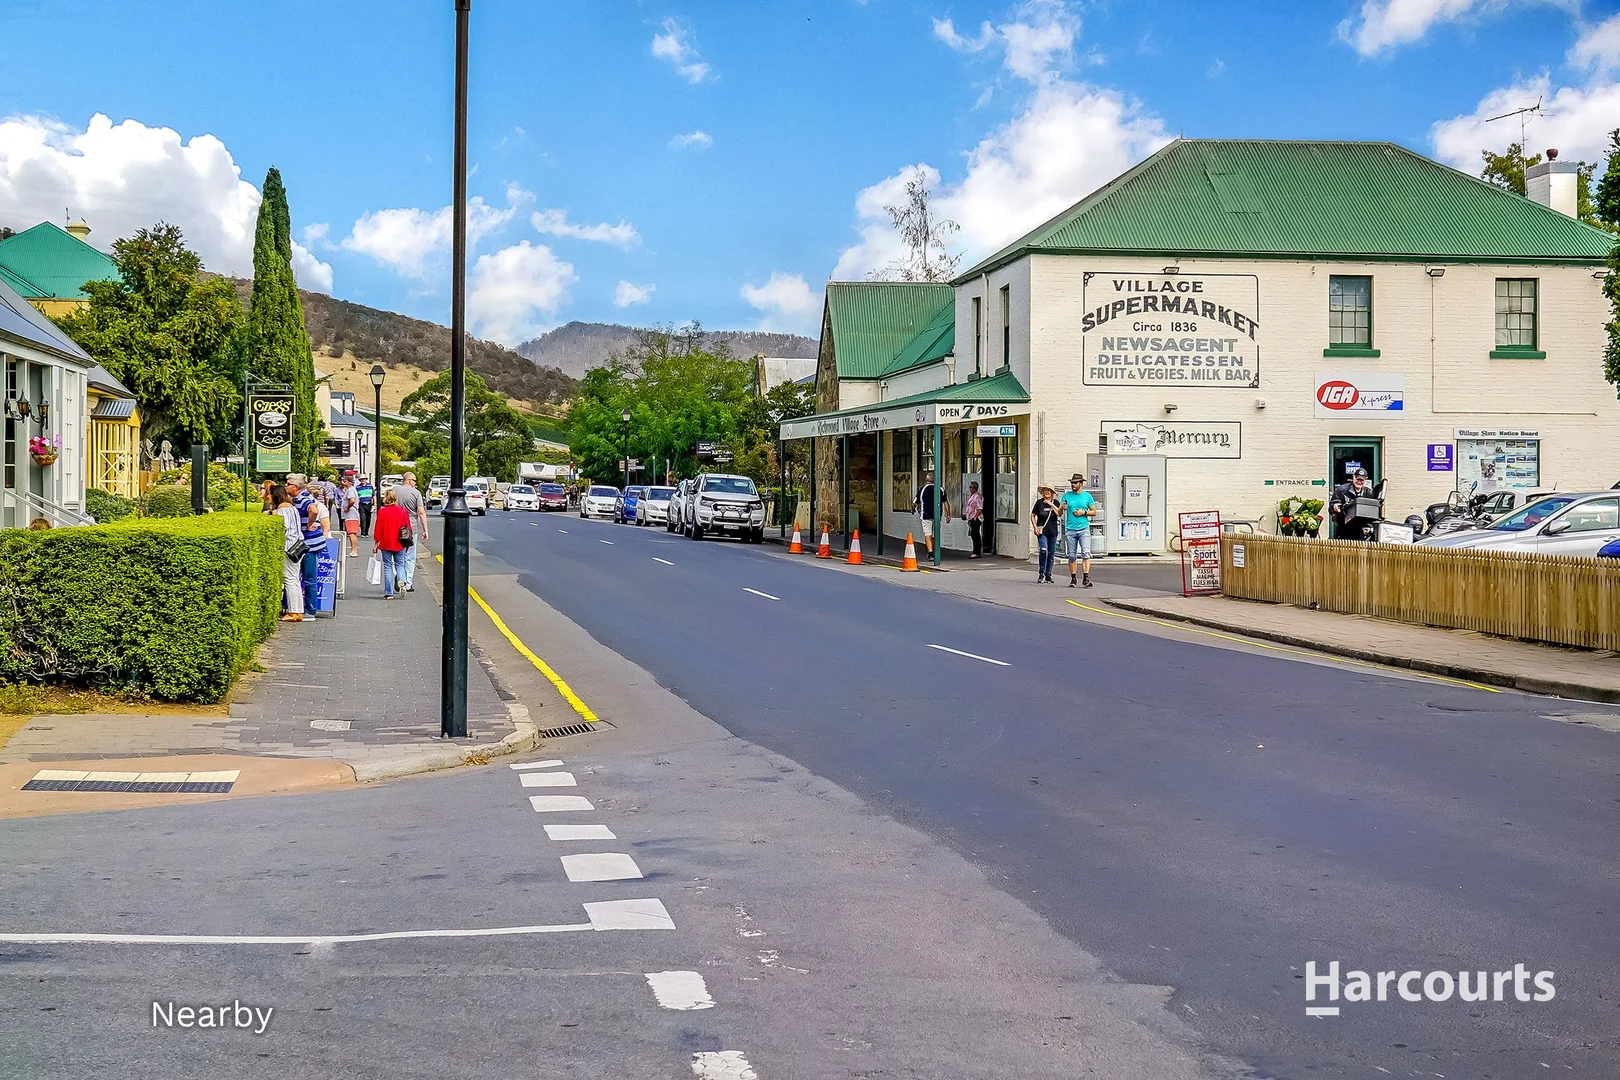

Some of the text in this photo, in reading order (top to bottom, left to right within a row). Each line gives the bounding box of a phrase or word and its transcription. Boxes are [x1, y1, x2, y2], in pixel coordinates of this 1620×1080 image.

[1112, 279, 1204, 293] VILLAGE
[1082, 295, 1259, 341] SUPERMARKET
[1133, 321, 1198, 332] Circa 1836
[1101, 337, 1239, 352] NEWSAGENT
[1098, 354, 1244, 367] DELICATESSEN
[1090, 367, 1127, 379] FRUIT
[1191, 369, 1221, 381] MILK
[1225, 369, 1252, 381] BAR
[1320, 386, 1356, 404] IGA
[1360, 393, 1393, 407] X-press
[939, 404, 1008, 420] OPEN 7 DAYS
[816, 414, 880, 435] Richmond Village Store
[1001, 426, 1015, 434] ATM
[1156, 429, 1231, 448] Mercury
[1194, 549, 1217, 560] Sport
